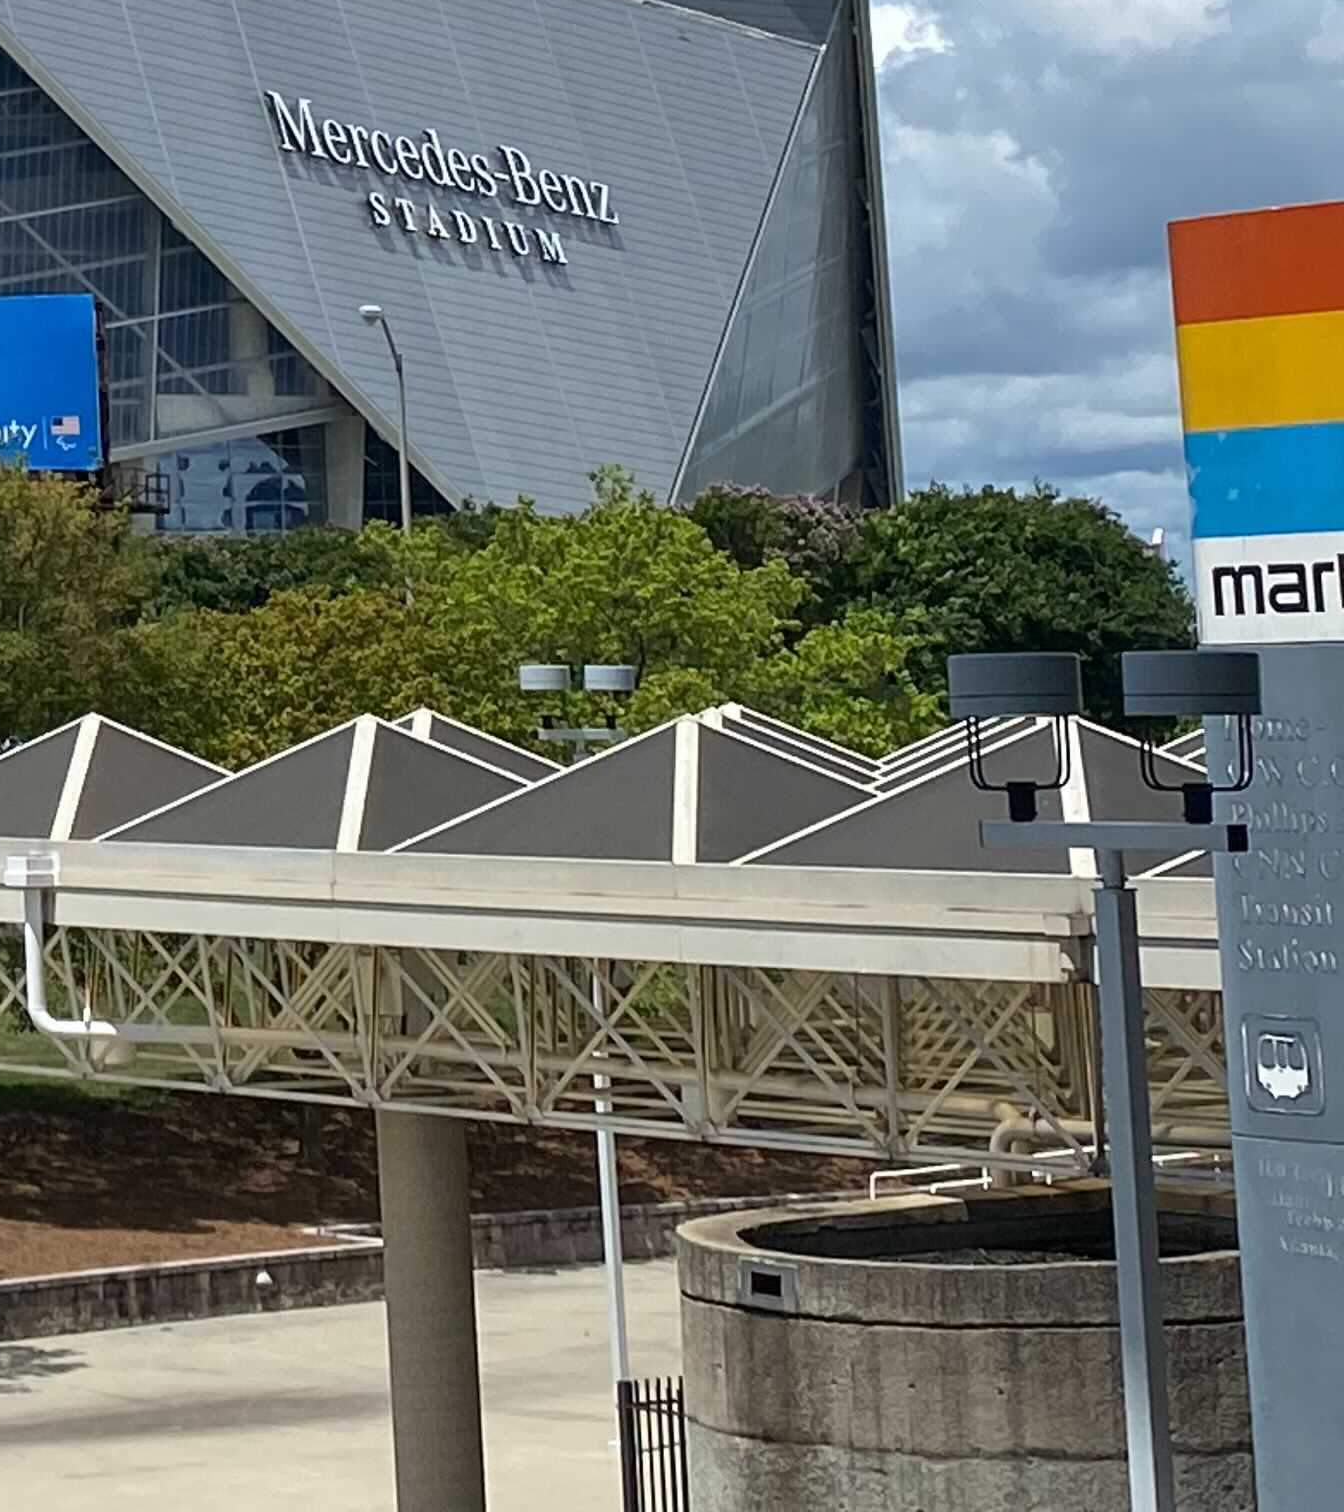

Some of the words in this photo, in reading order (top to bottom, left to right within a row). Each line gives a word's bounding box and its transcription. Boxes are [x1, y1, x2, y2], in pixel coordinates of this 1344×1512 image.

[265, 90, 620, 225] Mercedes-Benz
[368, 191, 569, 265] STADIUM
[1235, 890, 1335, 927] Transit
[1238, 936, 1338, 974] Station
